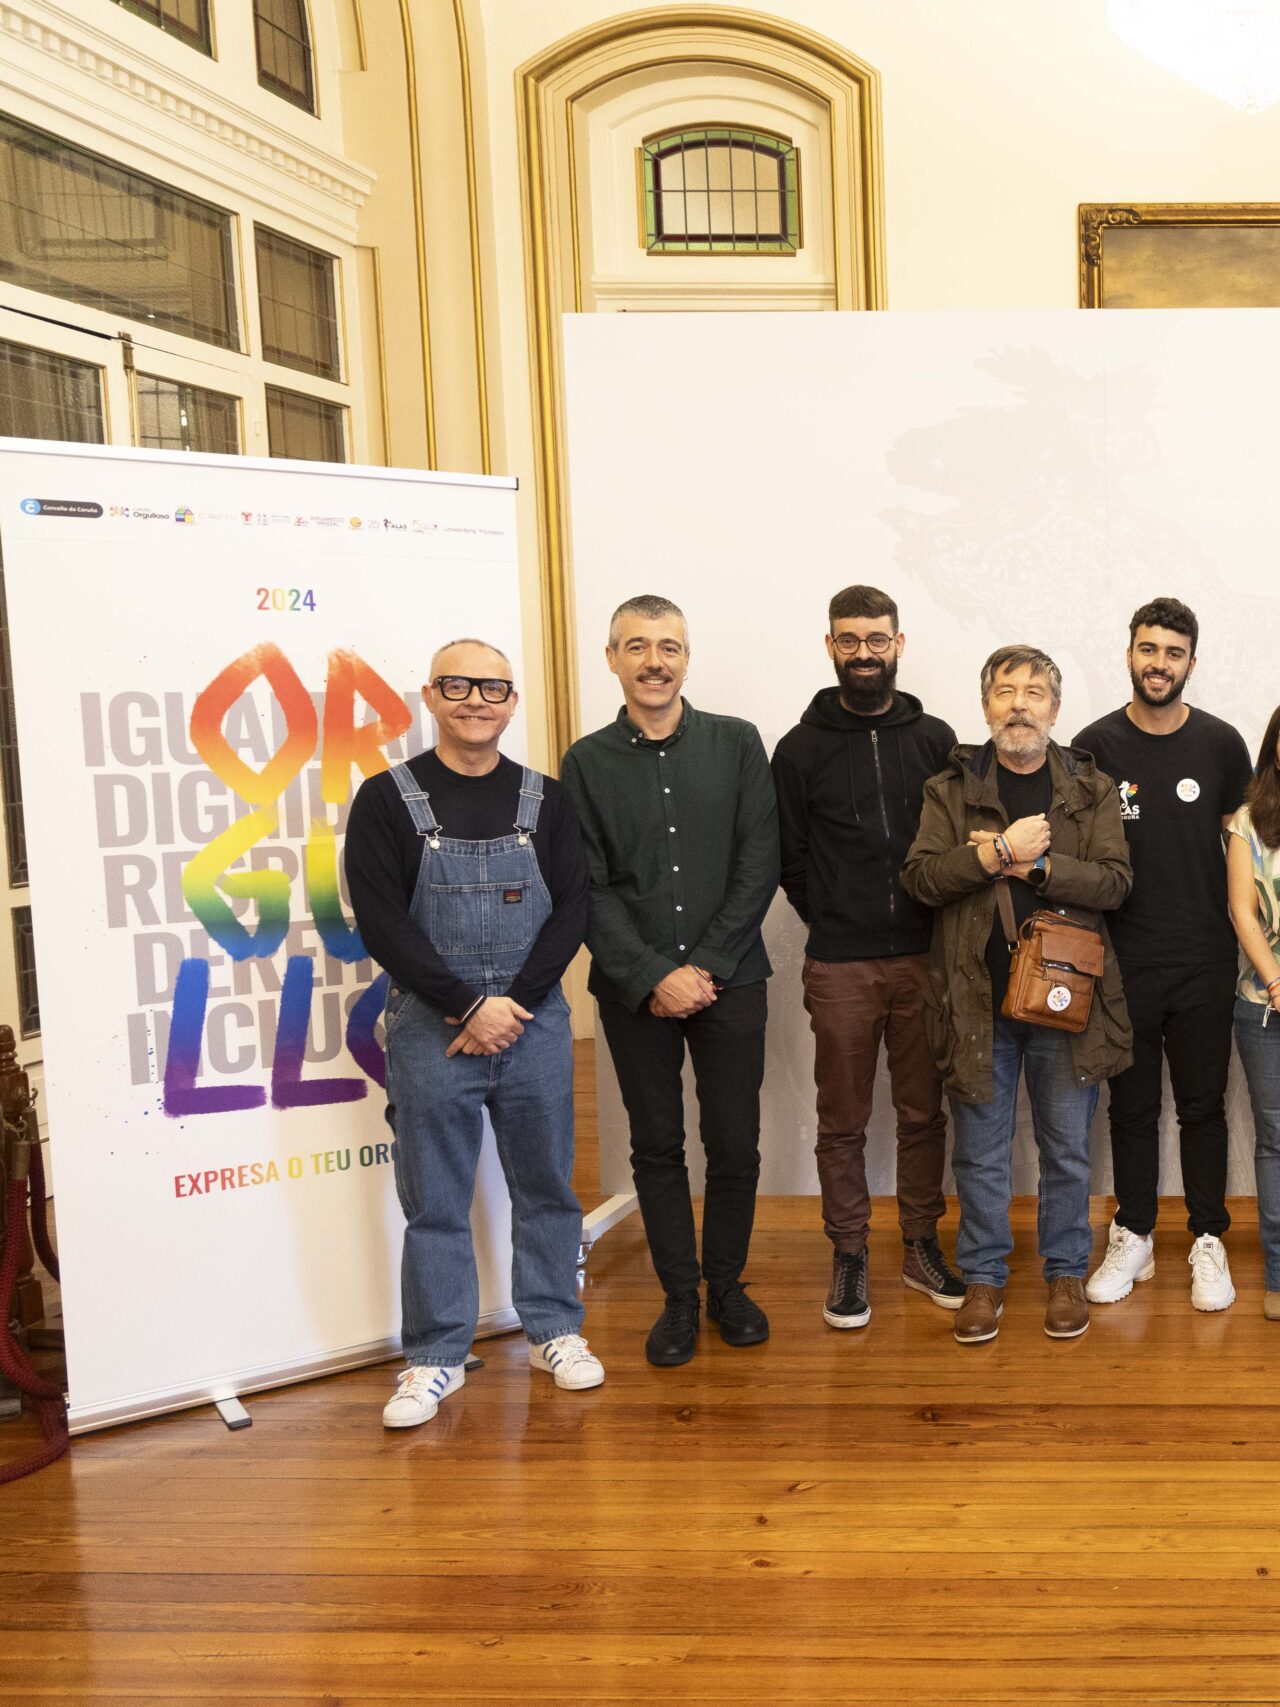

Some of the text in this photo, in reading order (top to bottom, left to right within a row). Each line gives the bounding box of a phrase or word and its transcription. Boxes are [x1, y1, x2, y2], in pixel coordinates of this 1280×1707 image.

[133, 511, 170, 519] Orgulloso
[256, 587, 317, 612] 2024
[189, 642, 413, 804] OR
[1120, 804, 1140, 815] LAS
[174, 1143, 398, 1199] EXPRESA O TEU OR
